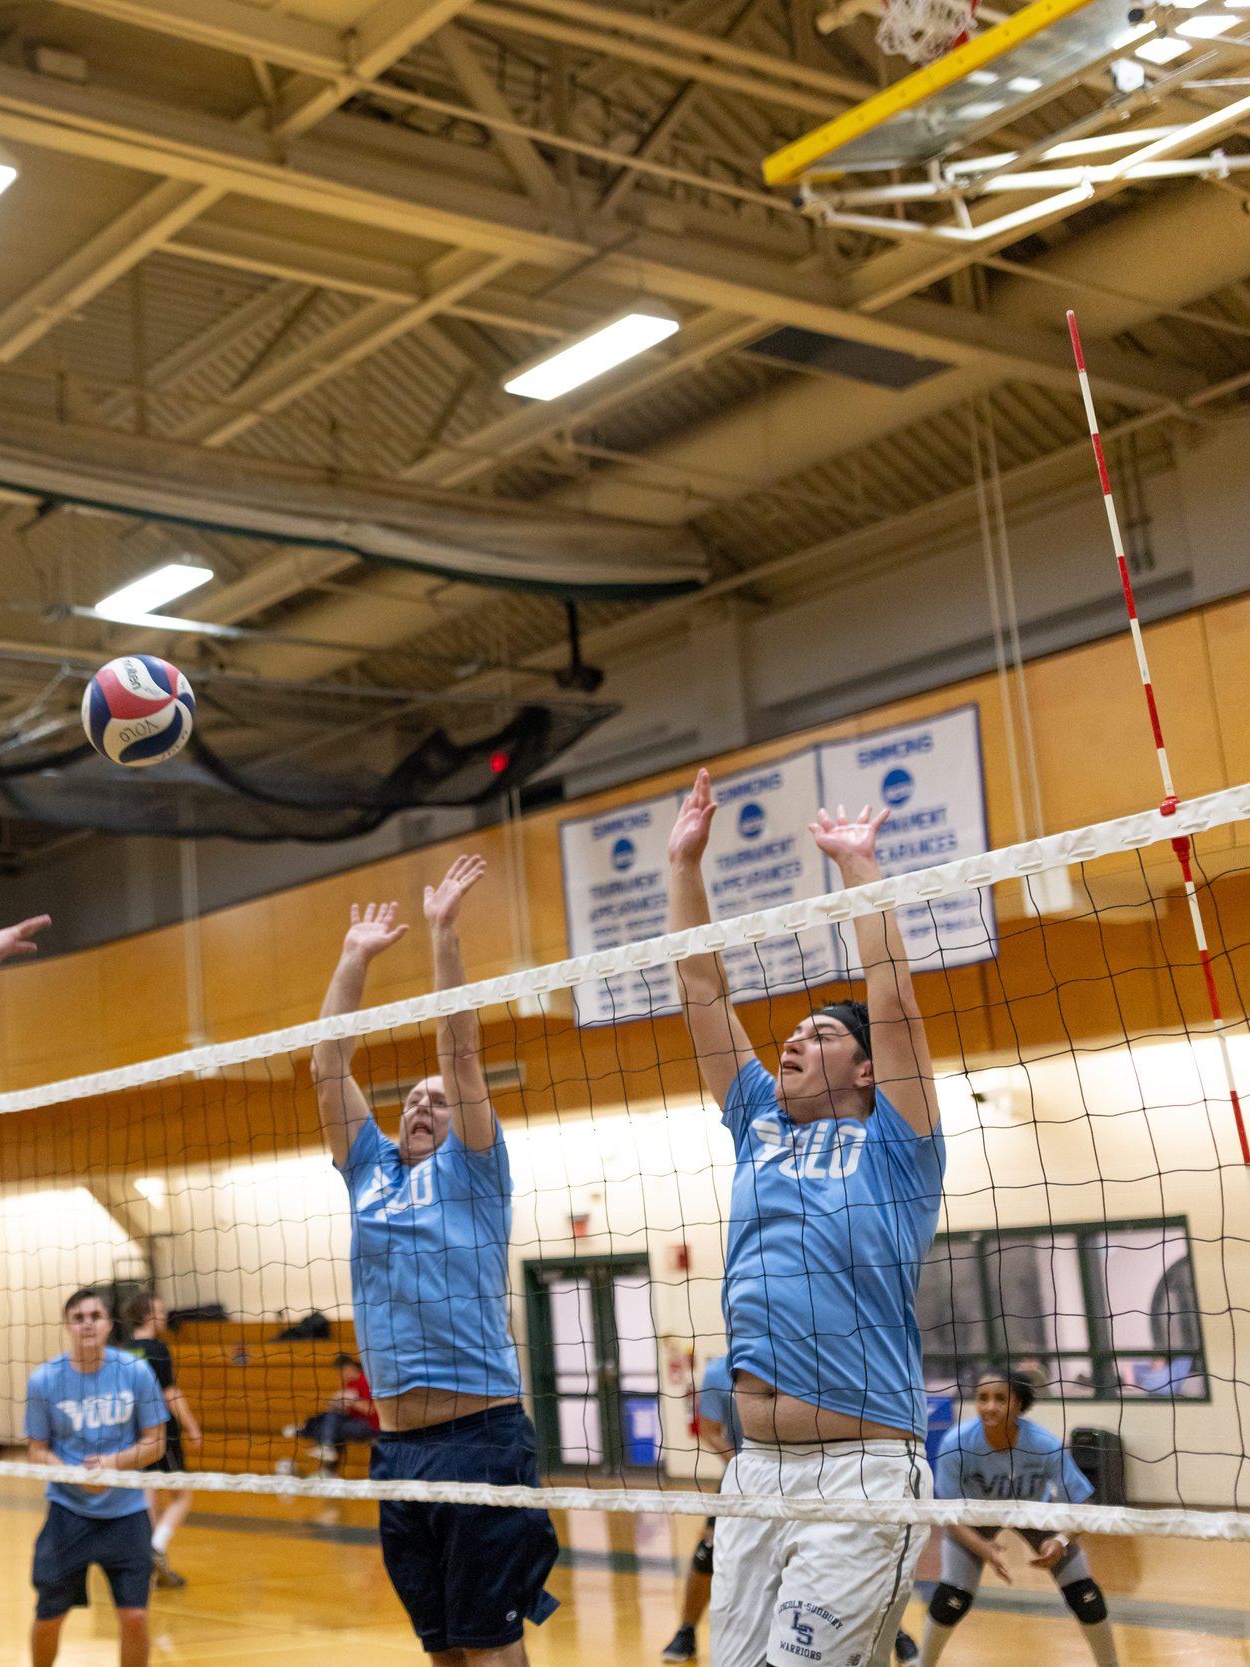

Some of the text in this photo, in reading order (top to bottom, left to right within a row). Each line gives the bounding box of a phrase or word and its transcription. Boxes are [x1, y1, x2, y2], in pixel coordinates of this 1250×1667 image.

[124, 659, 141, 690] olten
[119, 719, 159, 742] VOLO
[857, 732, 934, 769] SIMMONS
[716, 772, 783, 807] SIMMONS
[875, 830, 958, 865] EARANCES
[55, 1390, 135, 1431] VOLO
[791, 1611, 814, 1646] LS
[780, 1641, 822, 1661] WARRIORS
